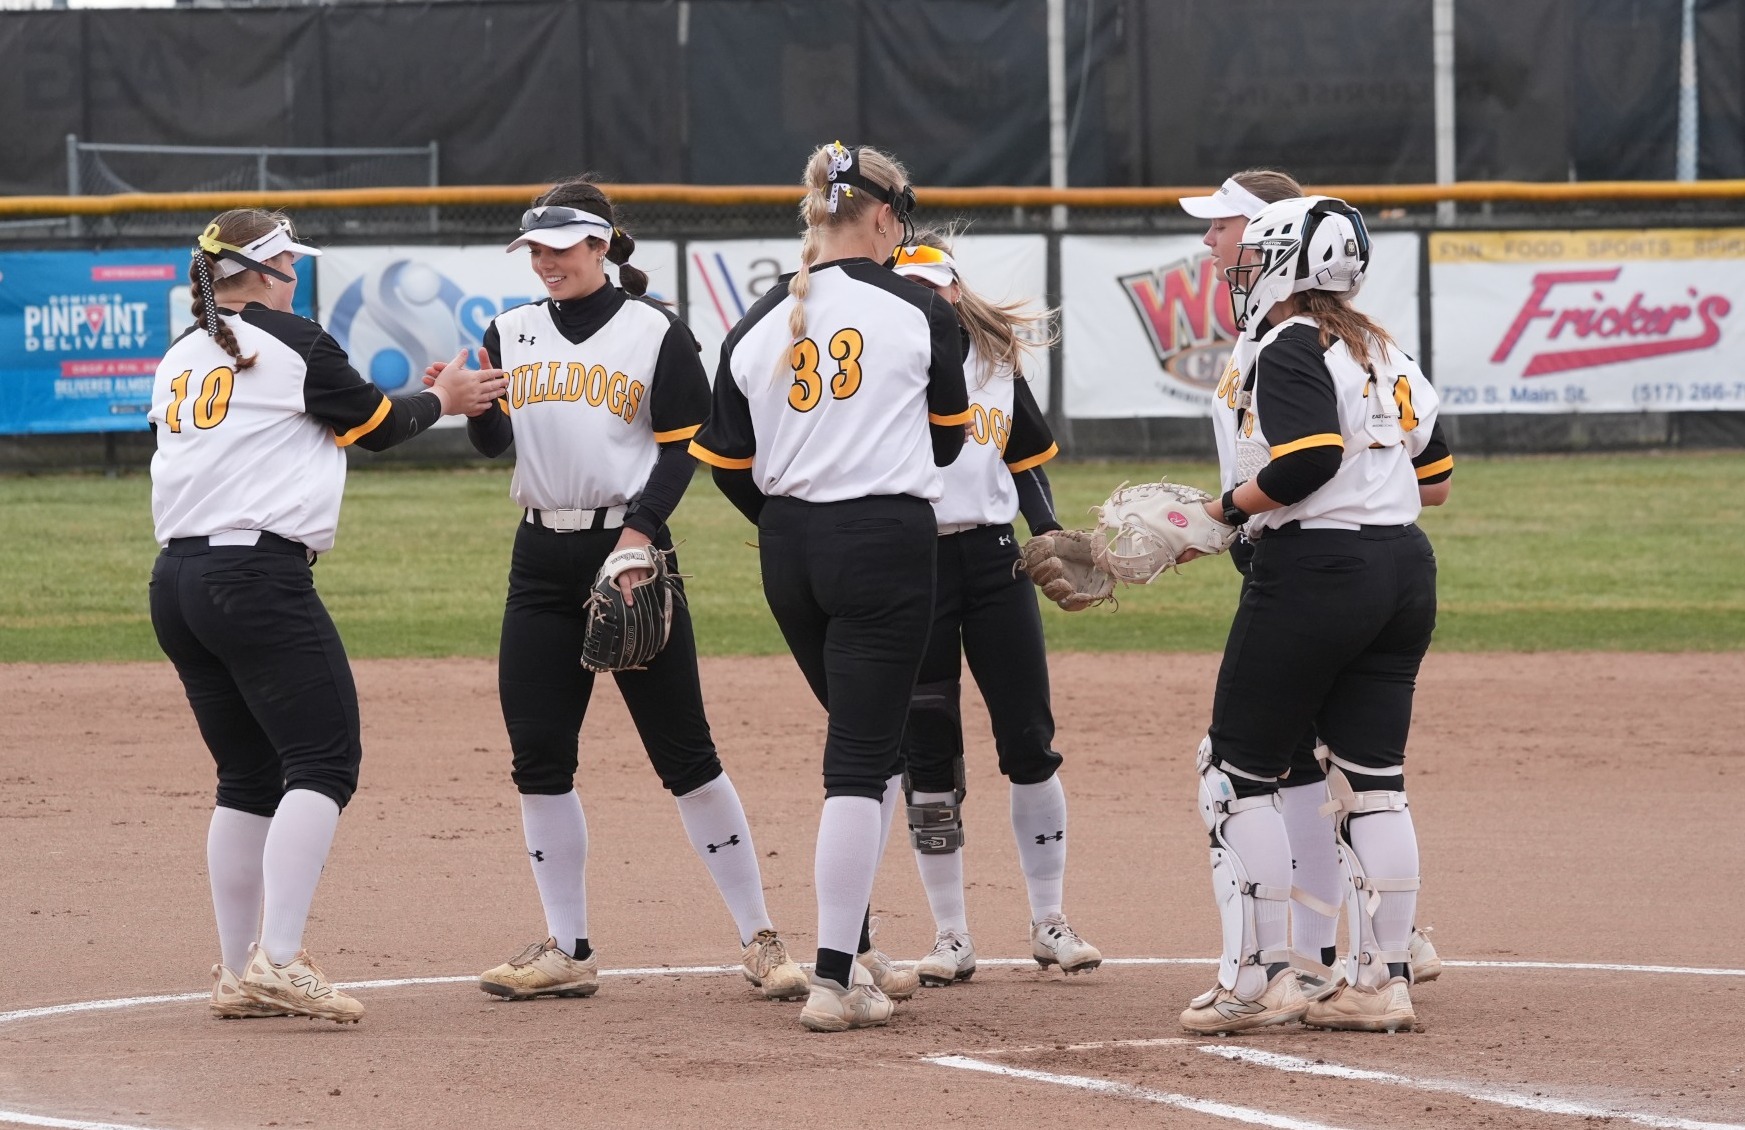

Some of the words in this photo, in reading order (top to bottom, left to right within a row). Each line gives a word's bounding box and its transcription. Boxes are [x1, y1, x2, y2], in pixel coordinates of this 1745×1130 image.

[1504, 240, 1564, 257] FOOD
[1586, 238, 1671, 257] SPORTS
[25, 335, 147, 351] DELIVERY
[788, 327, 864, 413] 33
[165, 366, 234, 433] 10
[504, 361, 645, 425] ULLDOGS
[1442, 386, 1477, 403] 720
[1510, 385, 1558, 402] Main
[1564, 384, 1589, 402] St.
[1632, 383, 1683, 404] (517)
[1690, 382, 1745, 402] 266-7
